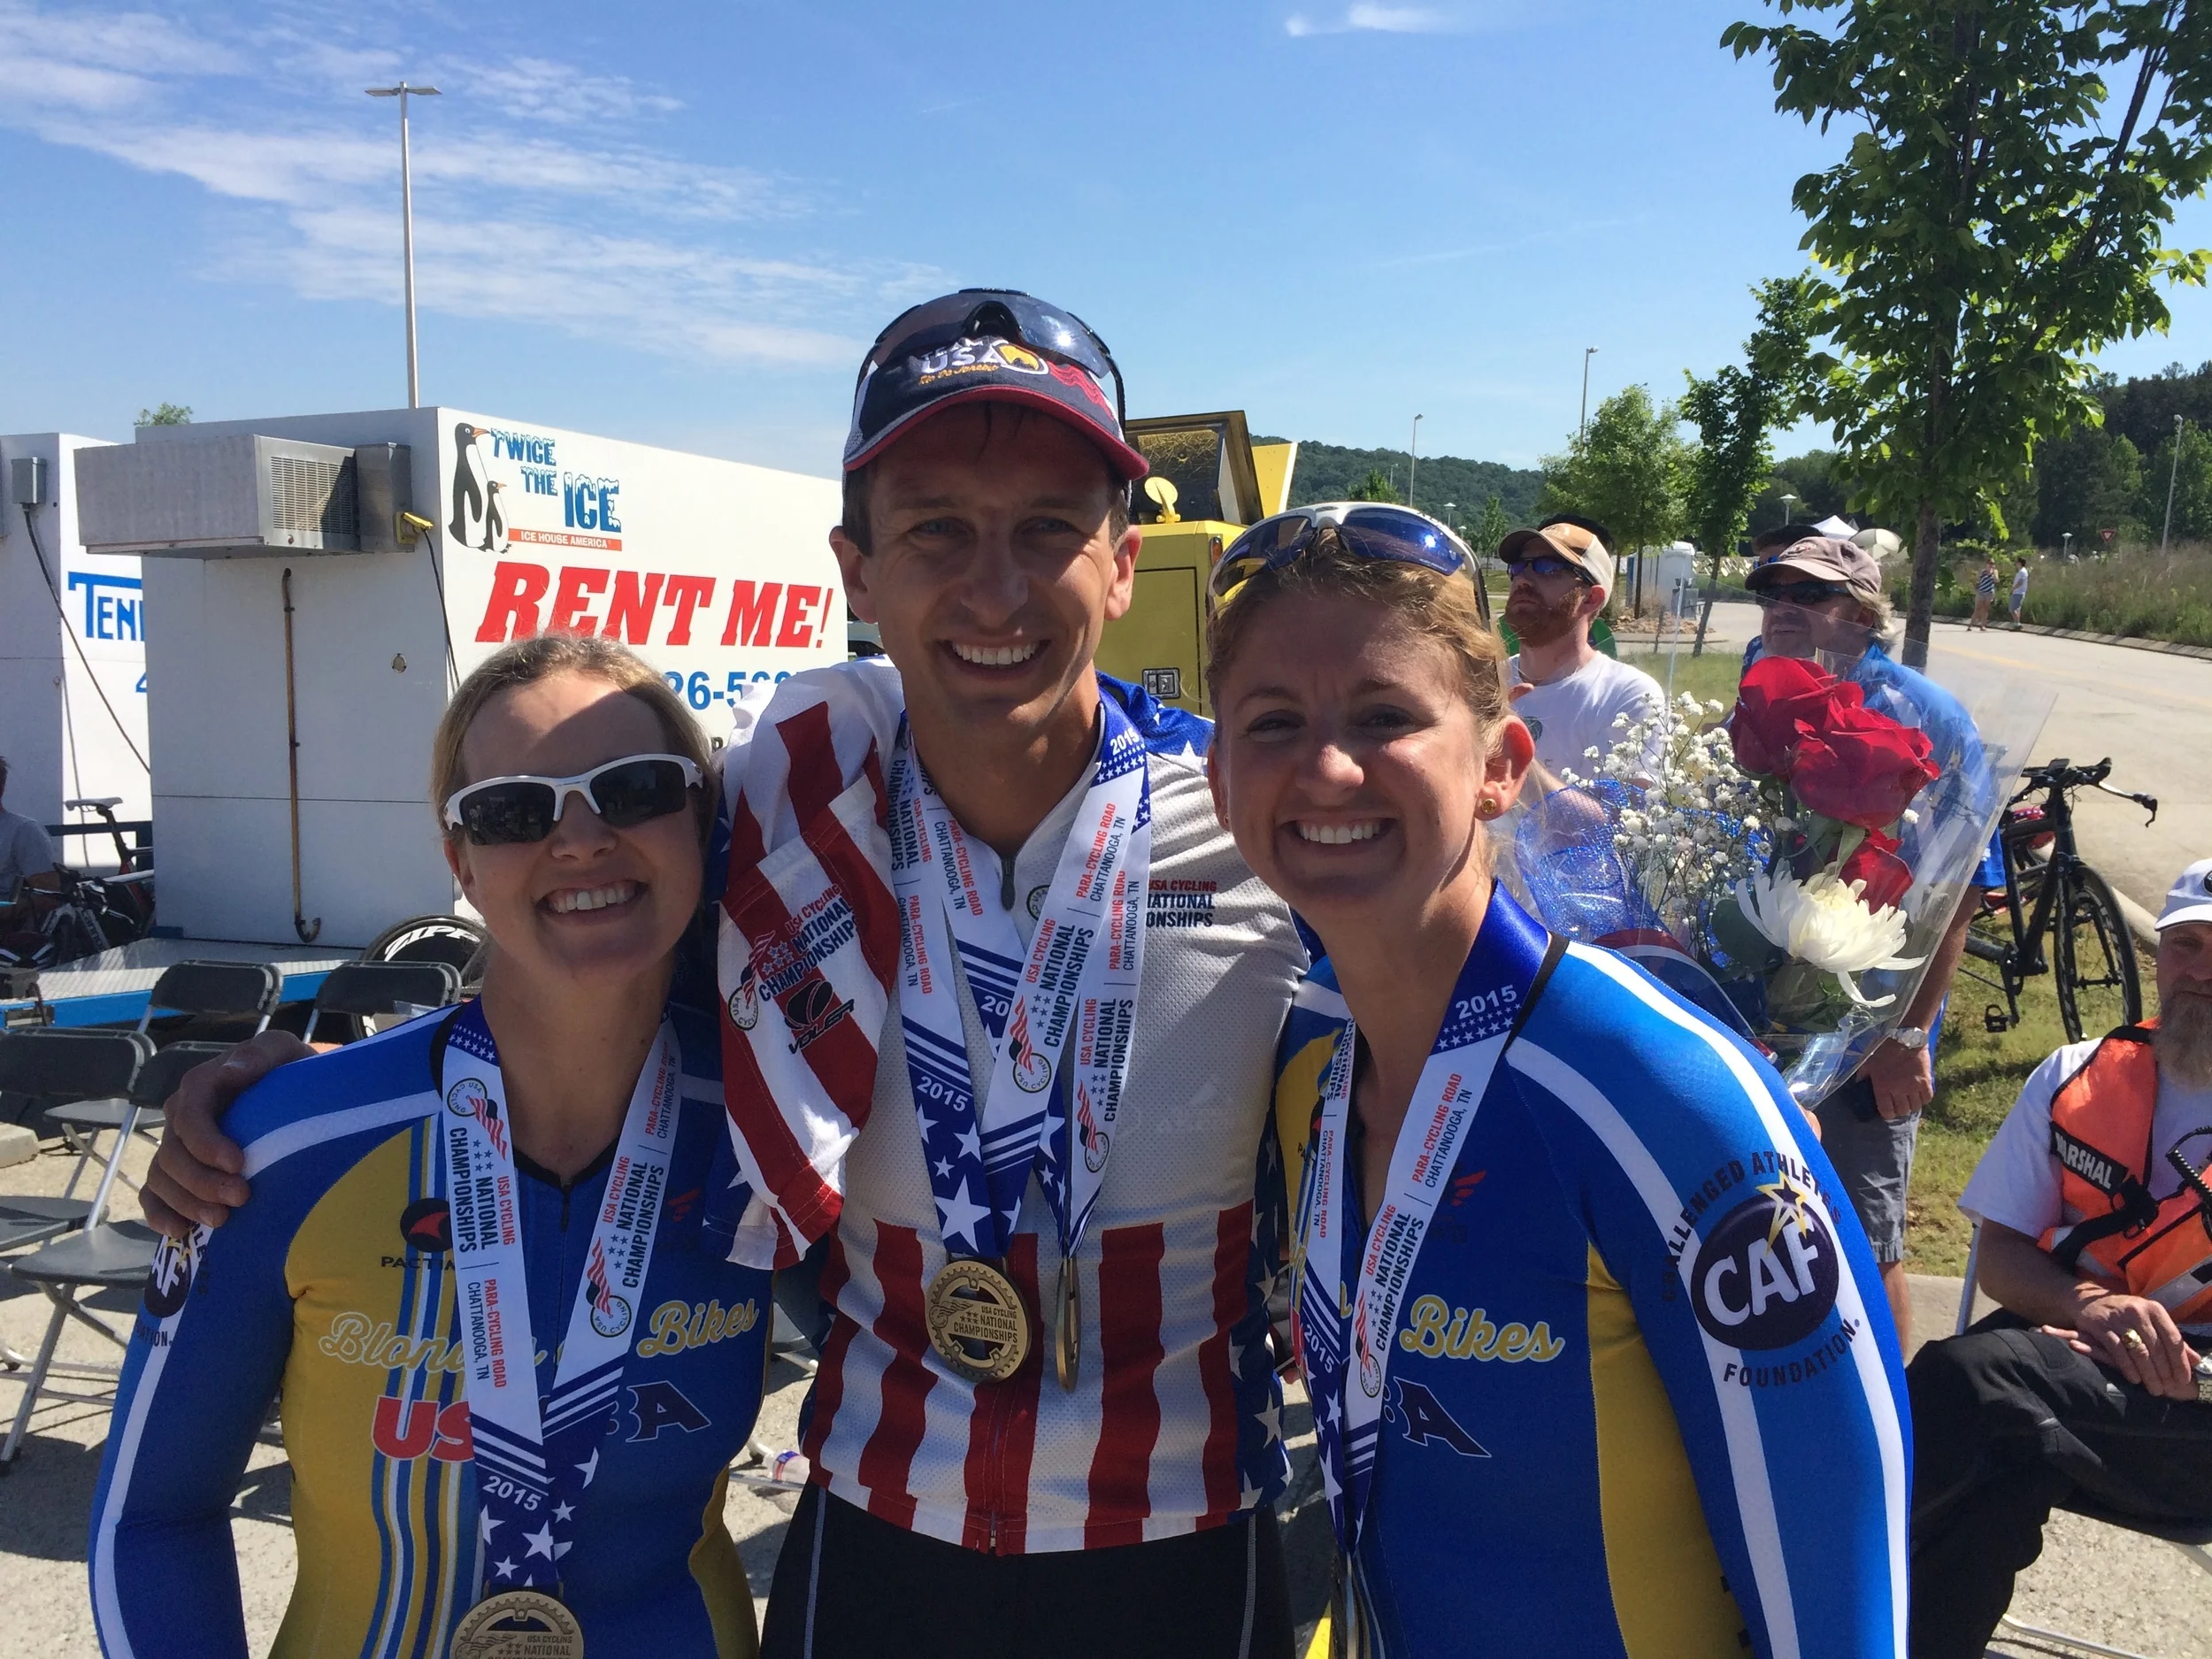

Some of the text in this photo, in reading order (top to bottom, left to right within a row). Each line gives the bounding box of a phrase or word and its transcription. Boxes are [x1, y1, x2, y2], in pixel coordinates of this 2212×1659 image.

[921, 344, 1005, 373] USA
[490, 427, 557, 466] TWICE
[520, 465, 622, 534] THE ICE
[520, 531, 608, 549] ICE HOUSE AMERICA
[475, 561, 834, 649] RENT ME!
[1110, 726, 1141, 756] 2015
[900, 798, 920, 870] NATIONAL
[917, 818, 933, 864] CYCLING
[934, 821, 966, 910] CHATTANOOGA, TN
[948, 819, 984, 917] PARA-CYCLING ROAD
[1076, 803, 1117, 899] PARA-CYCLING ROAD
[1090, 816, 1126, 902] CHATTANOOGA, TN
[785, 884, 842, 935] USA CYCLING
[1171, 879, 1217, 892] CYCLING
[792, 897, 854, 954] NATIONAL
[898, 897, 918, 987] CHATTANOOGA, TN
[910, 895, 933, 995] PARA-CYCLING ROAD
[1032, 918, 1056, 962] CYCLING
[1040, 925, 1076, 991] NATIONAL
[1110, 899, 1124, 970] PARA-CYCLING
[1123, 881, 1140, 971] CHATTANOOGA, TN
[1025, 961, 1041, 984] USA
[1044, 927, 1094, 1048] CHAMPIONSHIPS
[1455, 984, 1517, 1020] 2015
[788, 999, 855, 1055] VOLER
[1080, 998, 1097, 1065] USA CYCLING
[1094, 998, 1117, 1068] NATIONAL
[1104, 999, 1133, 1122] CHAMPIONSHIPS
[645, 1067, 666, 1135] PARA-CYCLING
[917, 1075, 969, 1113] 2015
[1411, 1072, 1463, 1184] PARA-CYCLING ROAD
[1322, 1130, 1334, 1207] PARA-CYCLING
[1425, 1109, 1468, 1188] CHATTANOOGA,
[1456, 1088, 1473, 1104] TN
[449, 1126, 478, 1253] CHAMPIONSHIPS
[475, 1176, 499, 1250] NATIONAL
[496, 1176, 515, 1246] USA CYCLING
[603, 1156, 631, 1224] USA CYCLING
[616, 1162, 648, 1231] NATIONAL
[1313, 1130, 1328, 1226] CHATTANOOGA, TN
[622, 1165, 664, 1288] CHAMPIONSHIPS
[1365, 1203, 1396, 1277] USA CYCLING
[1375, 1212, 1411, 1288] NATIONAL
[1662, 1151, 1841, 1302] CHALLENGED ATHLETES
[1376, 1217, 1425, 1352] CHAMPIONSHIPS
[1703, 1213, 1819, 1327] CAF
[467, 1281, 490, 1380] CHATTANOOGA, TN
[484, 1279, 507, 1388] PARA-CYCLING ROAD
[636, 1298, 760, 1358] Bikes
[953, 1321, 1018, 1343] CHAMPIONSHIPS
[980, 1314, 1018, 1331] NATIONAL
[993, 1308, 1018, 1319] CYCLING
[1303, 1324, 1335, 1373] 2015
[1399, 1294, 1565, 1363] Bikes
[482, 1475, 542, 1511] 2015
[524, 1645, 571, 1656] NATIONAL
